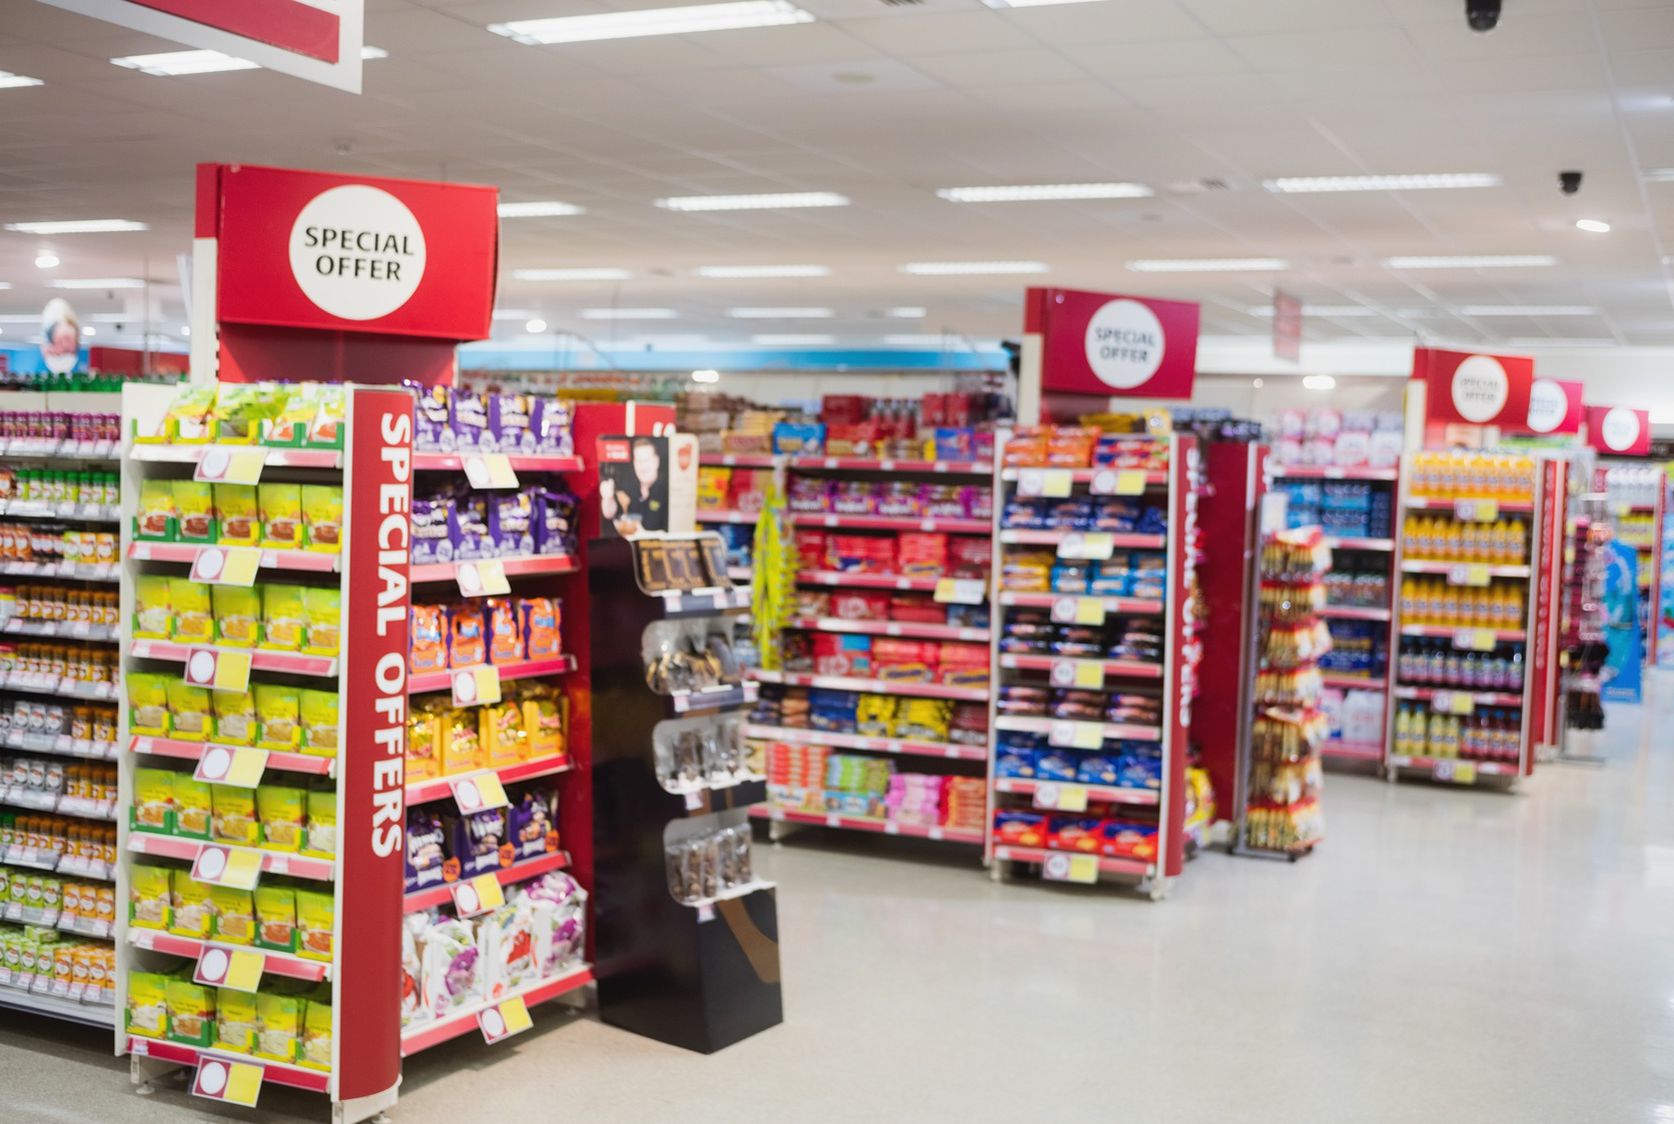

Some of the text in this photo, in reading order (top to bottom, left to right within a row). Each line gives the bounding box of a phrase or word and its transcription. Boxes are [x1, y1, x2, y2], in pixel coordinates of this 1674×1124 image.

[304, 226, 414, 256] SPECIAL
[315, 255, 401, 281] OFFER
[1095, 327, 1155, 347] SPECIAL
[1100, 345, 1148, 363] OFFER
[371, 412, 411, 858] SPECIAL OFFERS
